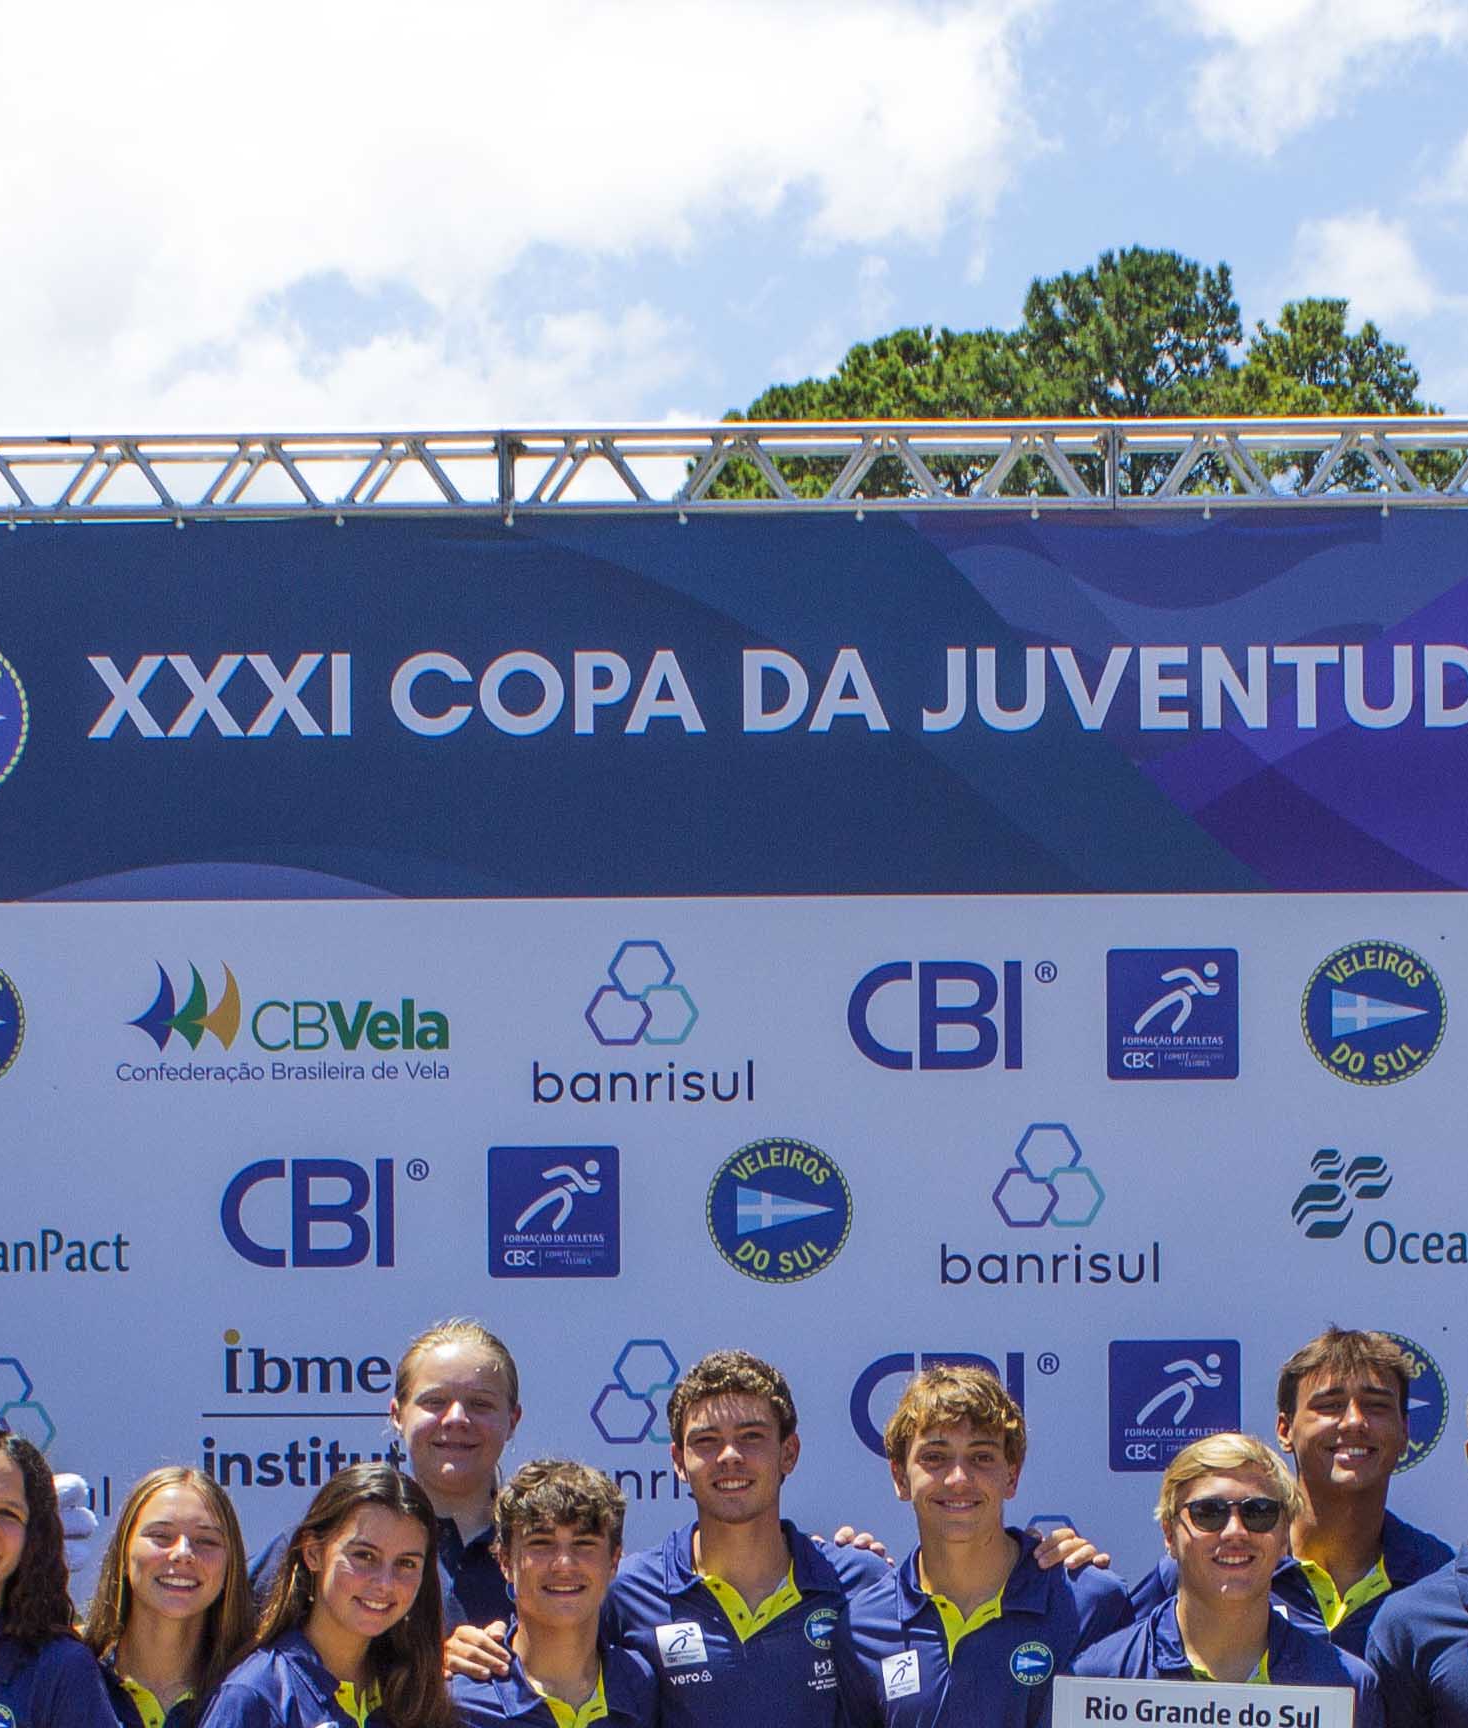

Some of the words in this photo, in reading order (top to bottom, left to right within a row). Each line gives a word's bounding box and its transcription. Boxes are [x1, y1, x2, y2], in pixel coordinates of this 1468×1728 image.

[87, 652, 352, 739] XXXI
[390, 649, 706, 737] COPA
[742, 648, 890, 734] DA
[1325, 950, 1425, 989] VELEIROS
[251, 999, 450, 1052] CBVela
[1122, 1036, 1171, 1048] FORMAÇÃO
[1173, 1036, 1184, 1046] DE
[1186, 1036, 1224, 1046] ATLETAS
[116, 1062, 264, 1085] Confederação
[272, 1062, 366, 1081] Brasileira
[372, 1062, 399, 1081] de
[405, 1061, 450, 1080] Vela
[1123, 1052, 1155, 1069] CBC
[1329, 1041, 1365, 1074] DO
[1373, 1042, 1422, 1076] SUL
[532, 1059, 755, 1104] banrisul
[730, 1148, 832, 1186] VELEIROS
[503, 1233, 552, 1245] FORMAÇÃO
[554, 1234, 565, 1244] DE
[566, 1234, 605, 1244] ATLETAS
[503, 1250, 536, 1267] CBC
[735, 1239, 771, 1273] DO
[778, 1240, 829, 1274] SUL
[940, 1242, 1160, 1284] banrisul
[224, 1329, 391, 1395] ibme
[1125, 1428, 1173, 1438] FORMAÇÃO
[1175, 1428, 1186, 1437] DE
[1125, 1444, 1156, 1460] CBC
[670, 1672, 699, 1686] vero
[1085, 1697, 1127, 1721] Rio
[1136, 1699, 1230, 1726] Grande
[1239, 1703, 1271, 1727] do
[1279, 1705, 1320, 1728] Sul
